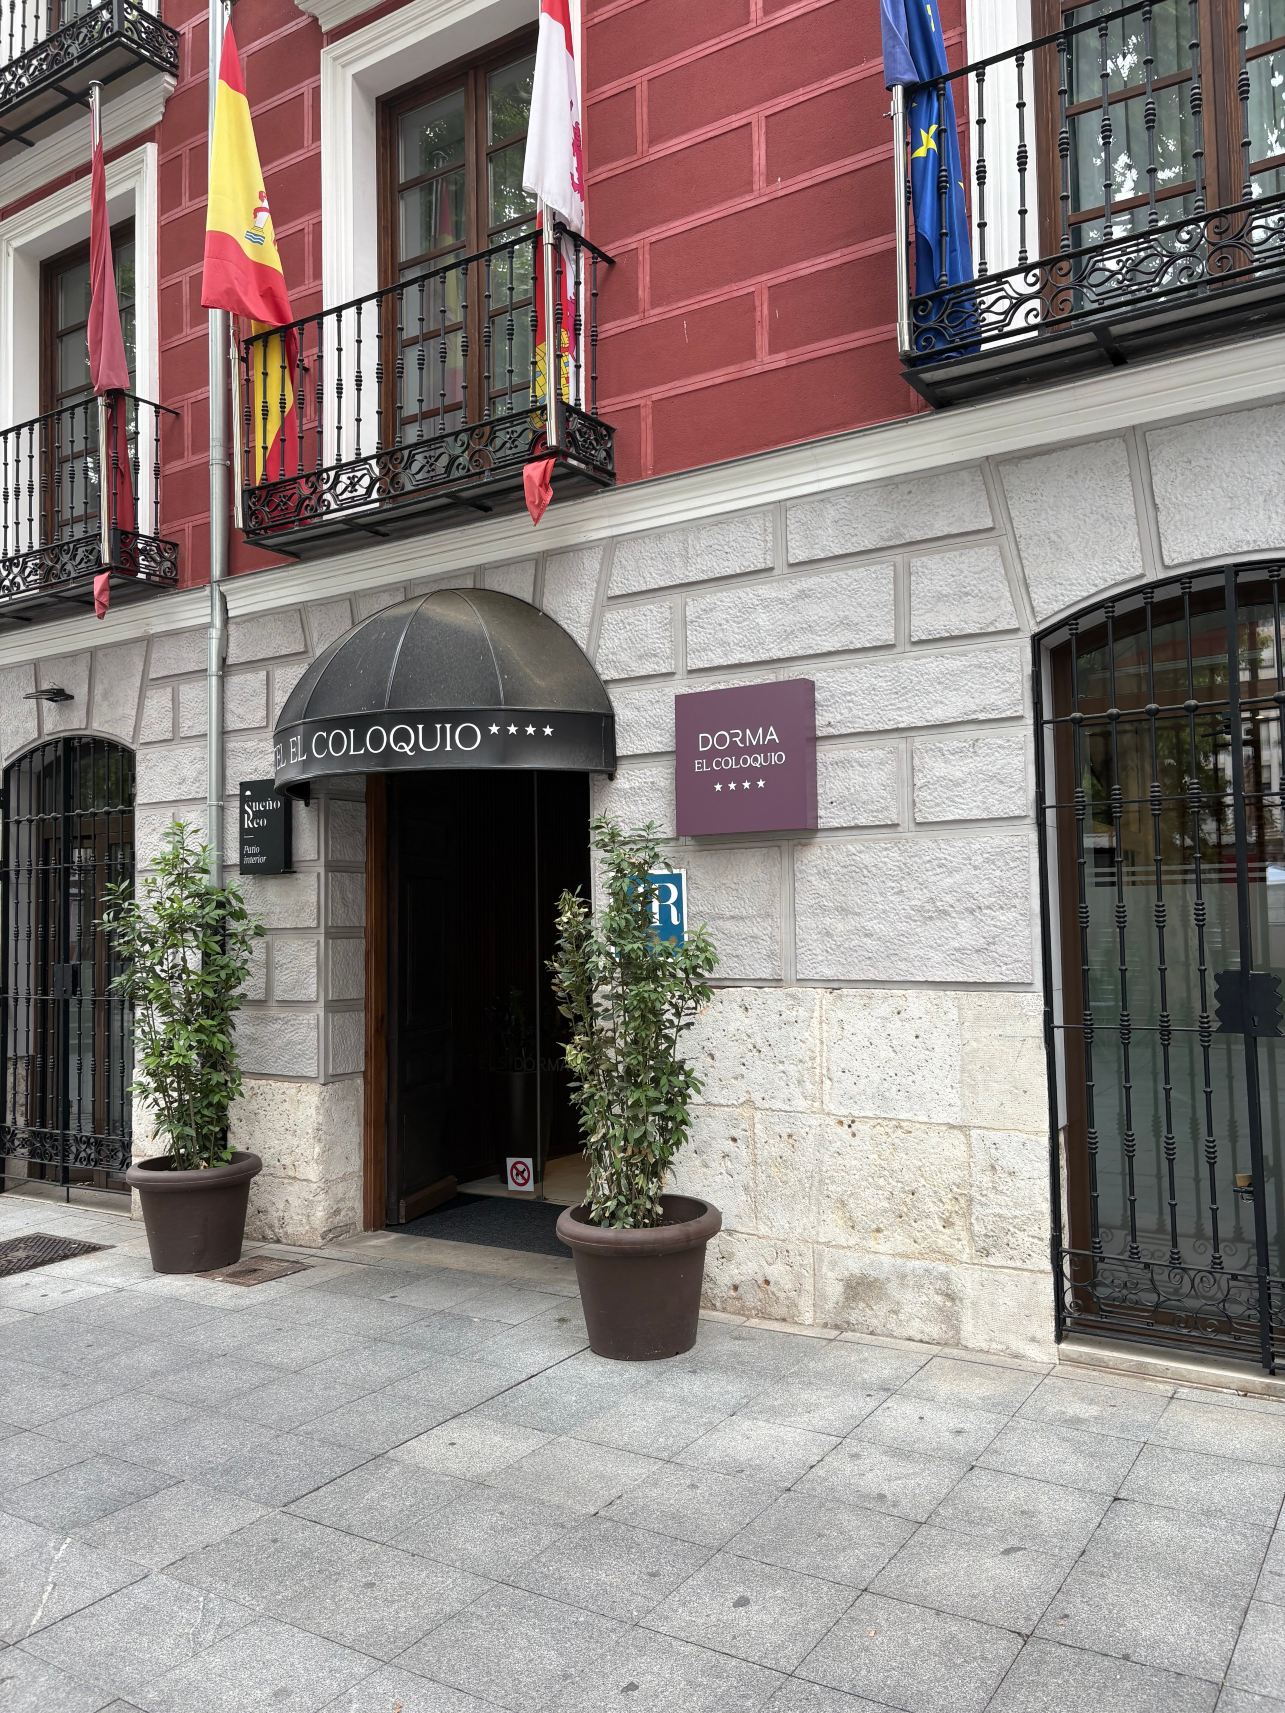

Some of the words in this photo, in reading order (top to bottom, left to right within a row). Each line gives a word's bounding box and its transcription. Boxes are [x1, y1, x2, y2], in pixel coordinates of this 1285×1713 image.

[289, 735, 308, 764] EL
[312, 723, 481, 758] COLOQUIO
[698, 725, 780, 752] DORMA
[694, 759, 711, 772] EL
[712, 751, 786, 770] COLOQUIO
[244, 797, 281, 817] Sueño
[243, 844, 261, 854] Patio
[243, 855, 268, 864] interior
